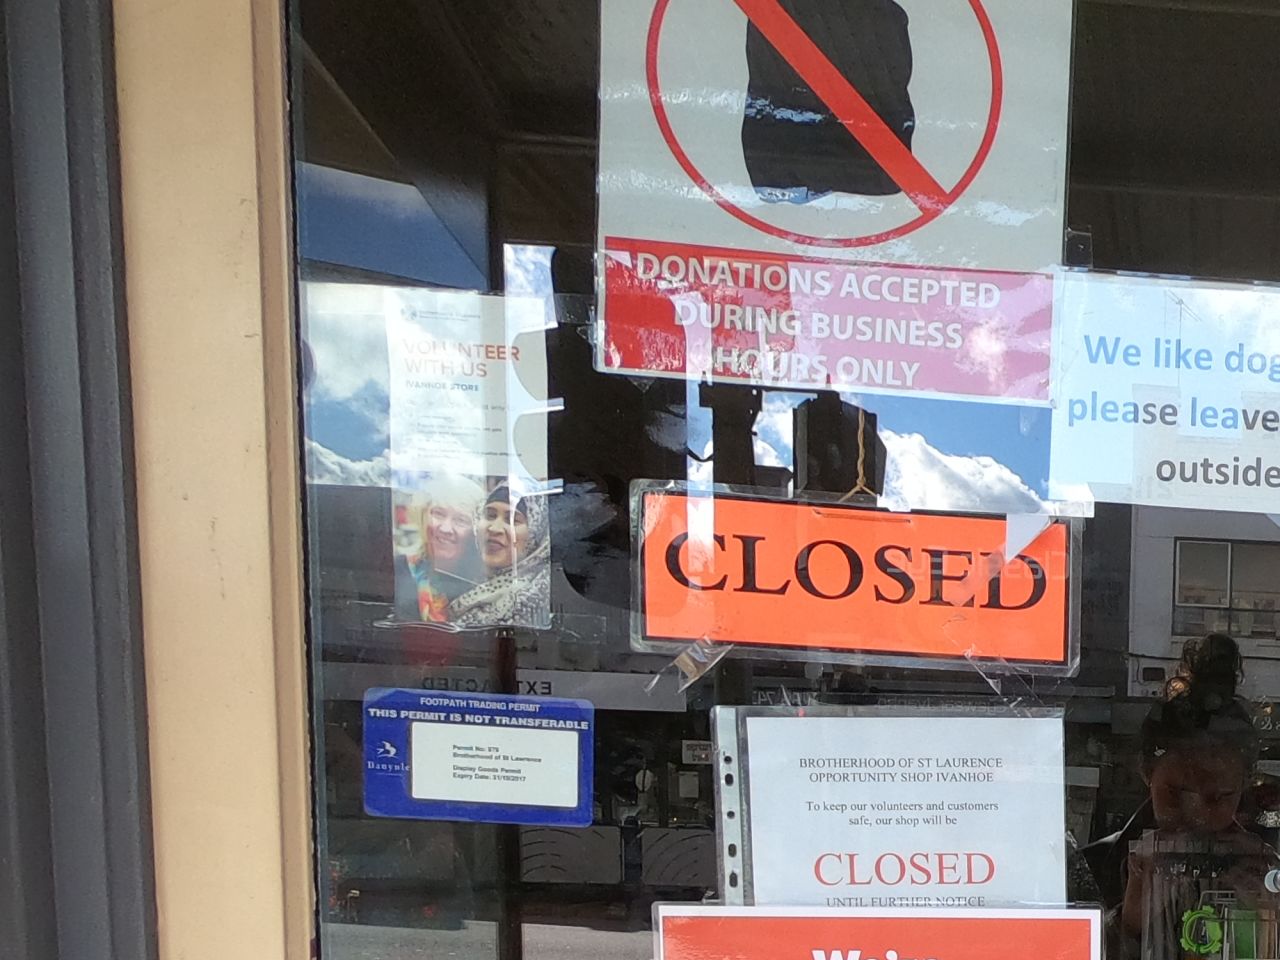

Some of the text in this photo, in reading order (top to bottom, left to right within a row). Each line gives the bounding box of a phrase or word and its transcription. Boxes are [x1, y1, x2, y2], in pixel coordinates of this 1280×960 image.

[637, 252, 1001, 309] DONATIONS ACCEPTED
[674, 299, 963, 350] DURING BUSINESS
[1084, 335, 1141, 367] We
[1154, 337, 1213, 371] like
[462, 363, 487, 377] US
[714, 346, 920, 388] HOURS ONLY
[1068, 391, 1178, 427] please
[1190, 397, 1280, 433] leave
[665, 532, 1047, 611] CLOSED
[420, 697, 541, 713] FOOTPATH TRADING PERMIT
[368, 707, 588, 730] THIS PERMIT IS NOT TRANSFERABLE
[799, 757, 1002, 769] BROTHERHOOD OF ST LAURENCE
[809, 772, 994, 783] OPPORTUNITY SHOP IVANHOE
[805, 801, 820, 811] To
[823, 801, 848, 813] keep
[870, 801, 923, 811] volunteers
[926, 801, 945, 811] and
[948, 802, 999, 811] customers
[848, 815, 958, 828] safe, our shop will be
[813, 852, 996, 886] CLOSED
[826, 896, 985, 907] UNTIL FURTHER NOTICE
